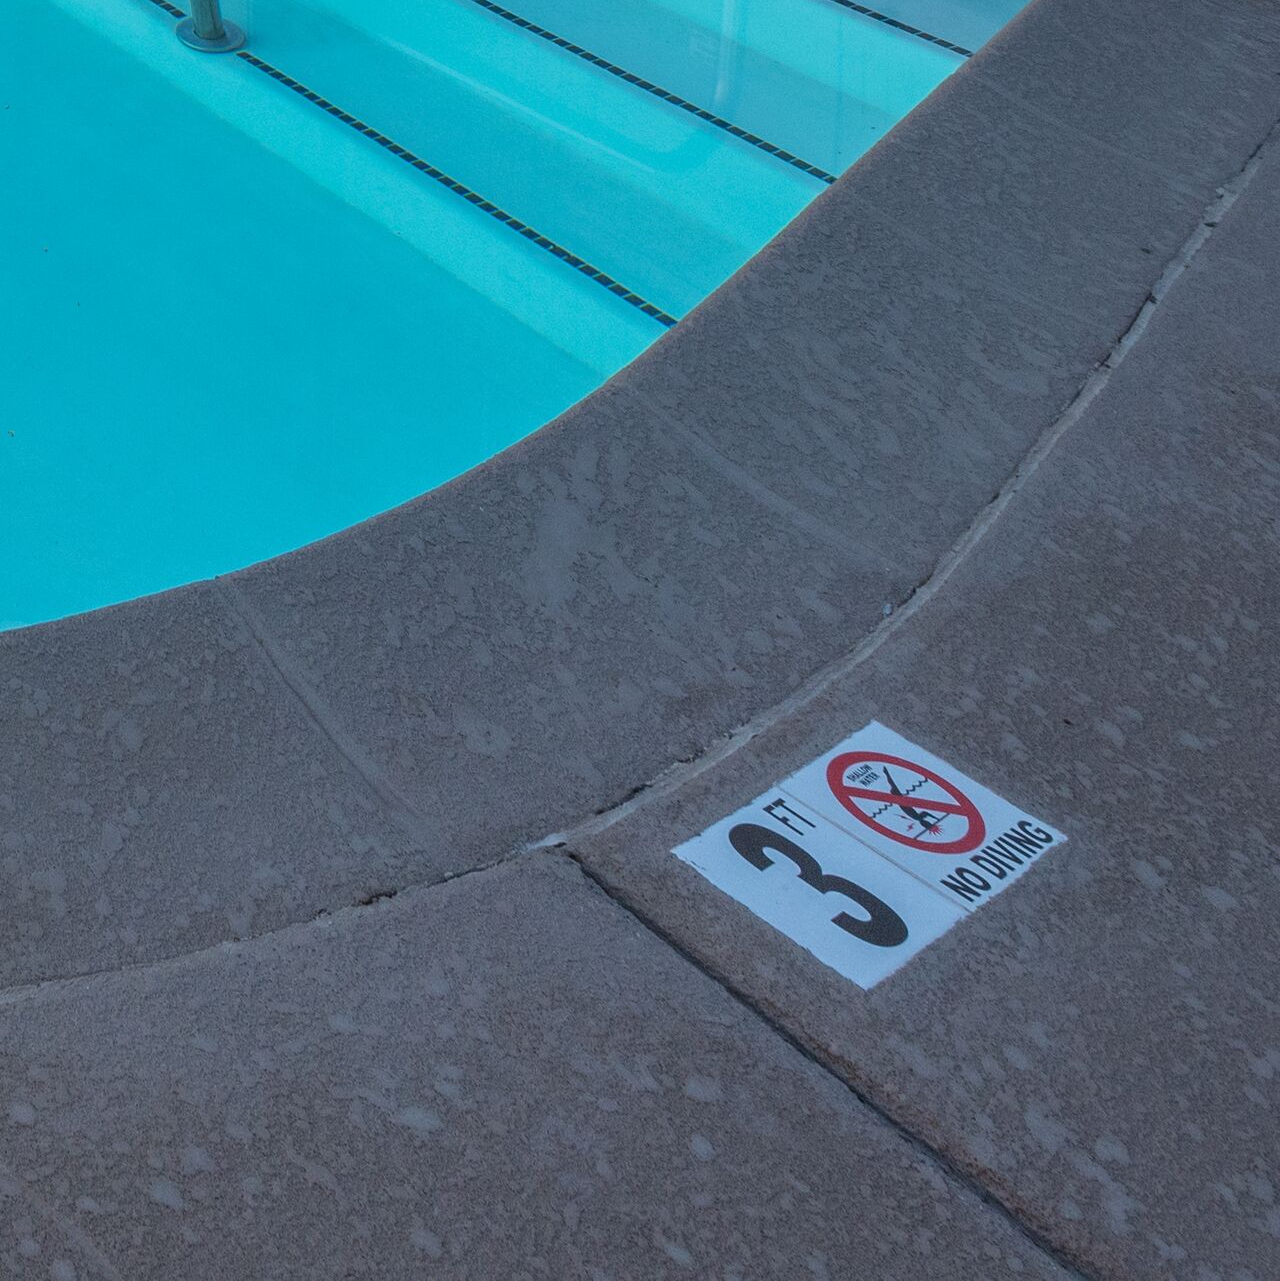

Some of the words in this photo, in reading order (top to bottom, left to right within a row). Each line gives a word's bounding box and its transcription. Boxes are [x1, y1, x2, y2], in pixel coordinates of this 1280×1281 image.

[860, 771, 881, 788] WATER
[763, 798, 816, 836] FT
[729, 822, 909, 947] 3
[940, 866, 992, 903] NO
[983, 819, 1054, 881] DIVING
